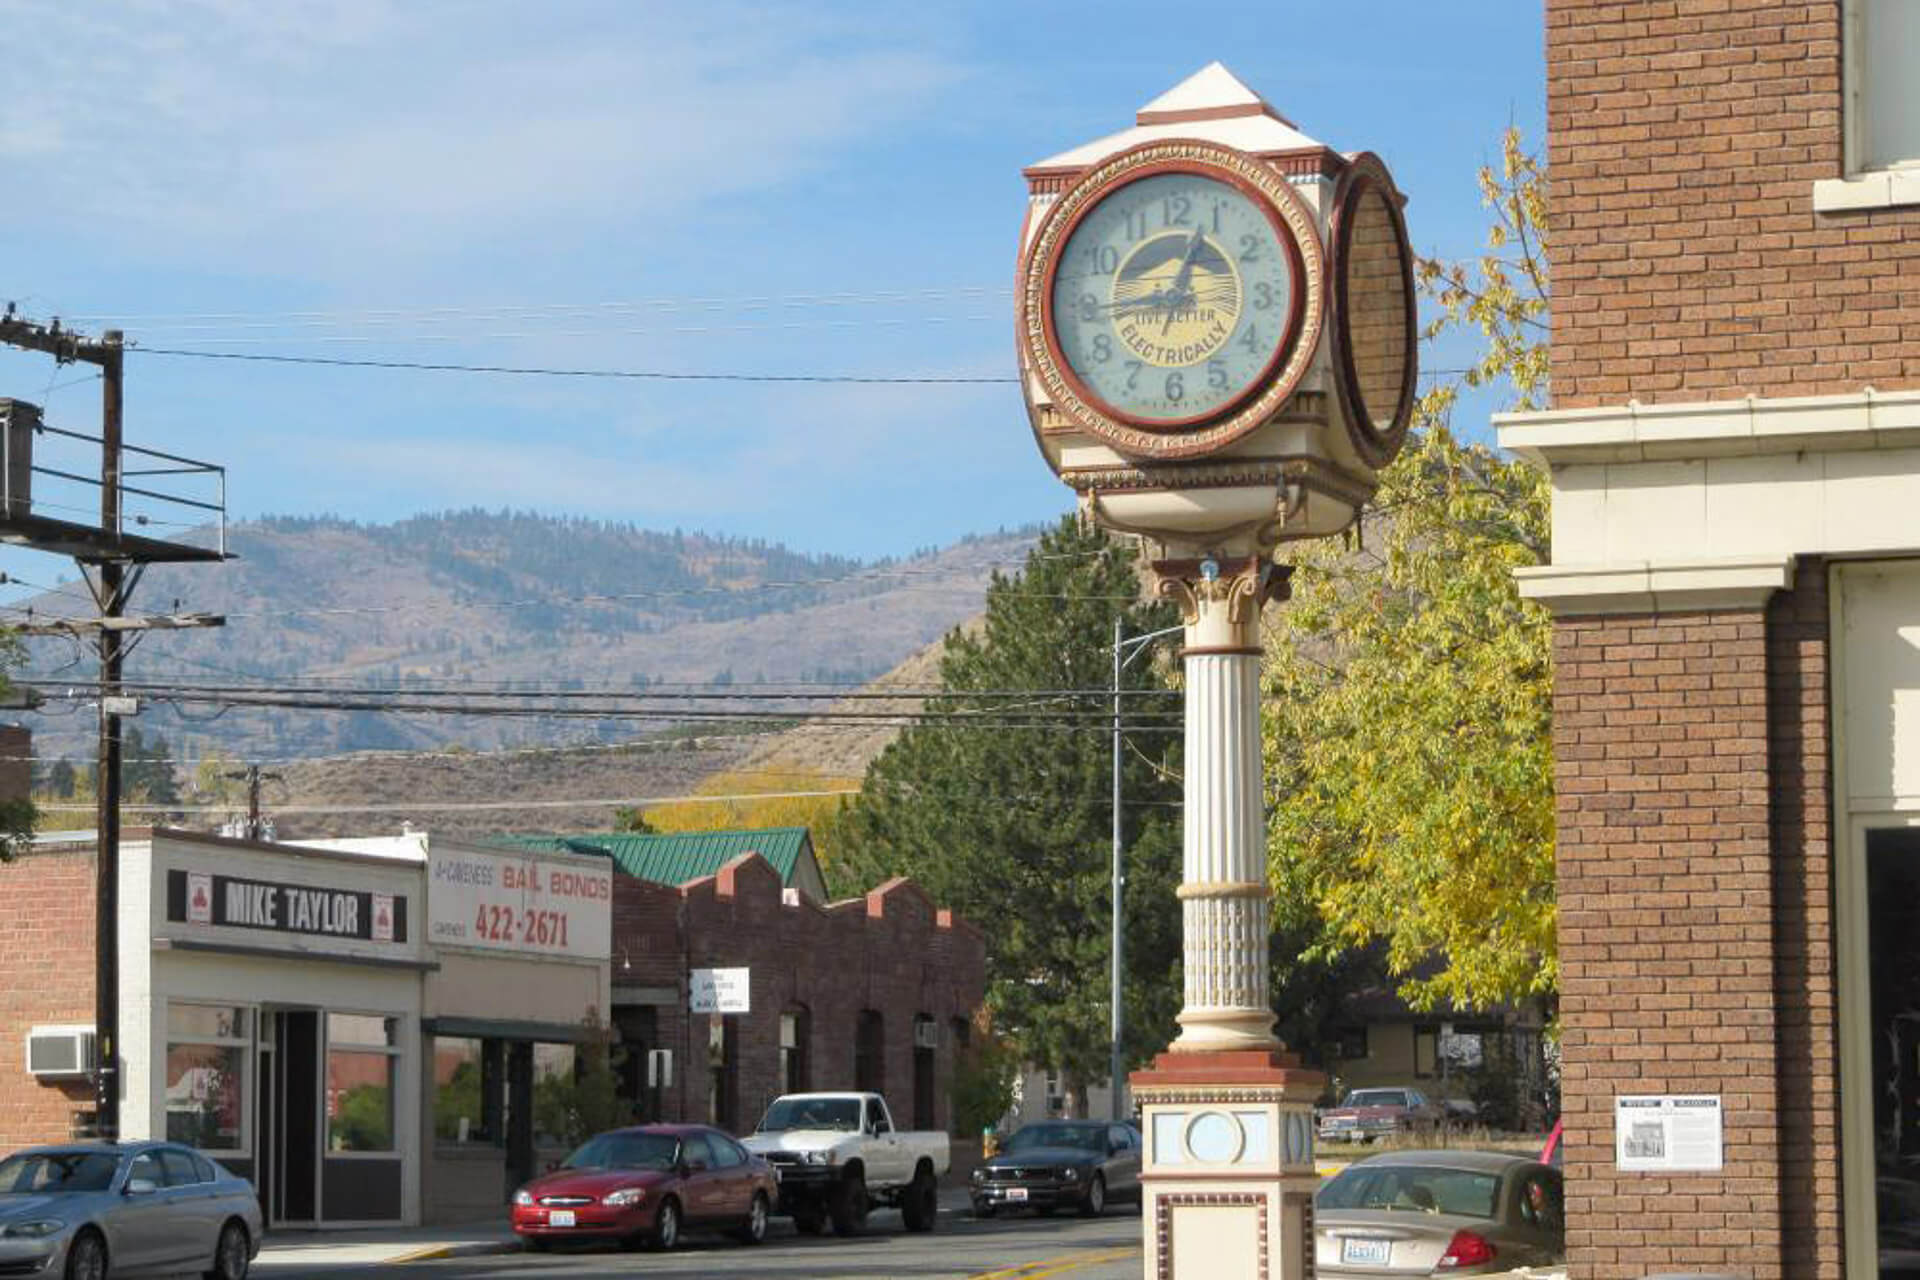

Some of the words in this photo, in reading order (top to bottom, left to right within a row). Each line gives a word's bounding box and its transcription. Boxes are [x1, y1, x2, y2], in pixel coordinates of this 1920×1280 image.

[1125, 210, 1146, 241] 11
[1163, 197, 1191, 226] 12
[1212, 199, 1220, 234] 1
[1090, 245, 1118, 276] 10
[1240, 235, 1259, 262] 2
[1253, 282, 1272, 310] 3
[1169, 309, 1215, 323] ETTER
[1093, 334, 1112, 364] 8
[1121, 320, 1228, 364] ELECTRICALLY
[1239, 323, 1258, 354] 4
[1124, 360, 1143, 391] 7
[1165, 372, 1185, 401] 6
[1208, 360, 1228, 389] 5
[503, 864, 542, 892] BAIL
[551, 871, 609, 901] BONDS
[225, 881, 278, 927] MIKE
[284, 888, 358, 934] TAYLOR
